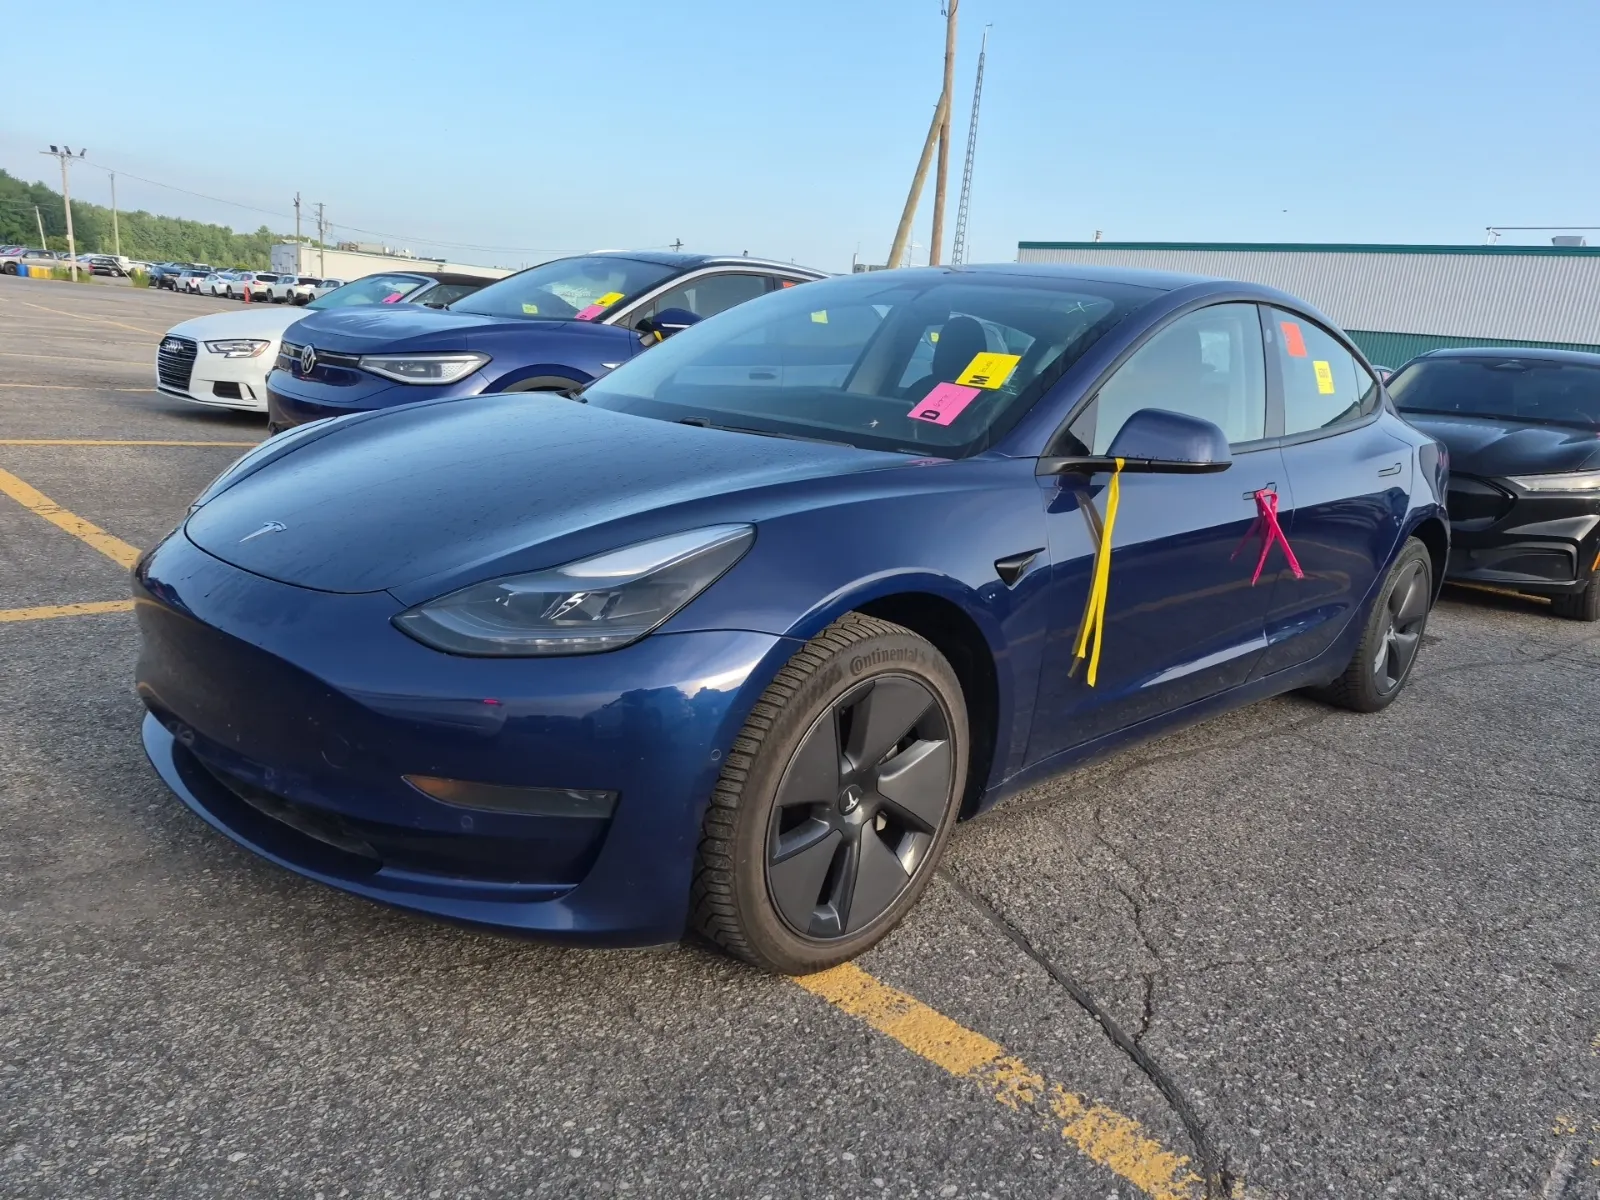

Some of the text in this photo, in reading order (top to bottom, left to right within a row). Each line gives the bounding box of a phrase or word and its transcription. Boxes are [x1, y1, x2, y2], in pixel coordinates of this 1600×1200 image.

[968, 374, 990, 385] M
[920, 409, 941, 421] D
[850, 647, 918, 677] Continental
